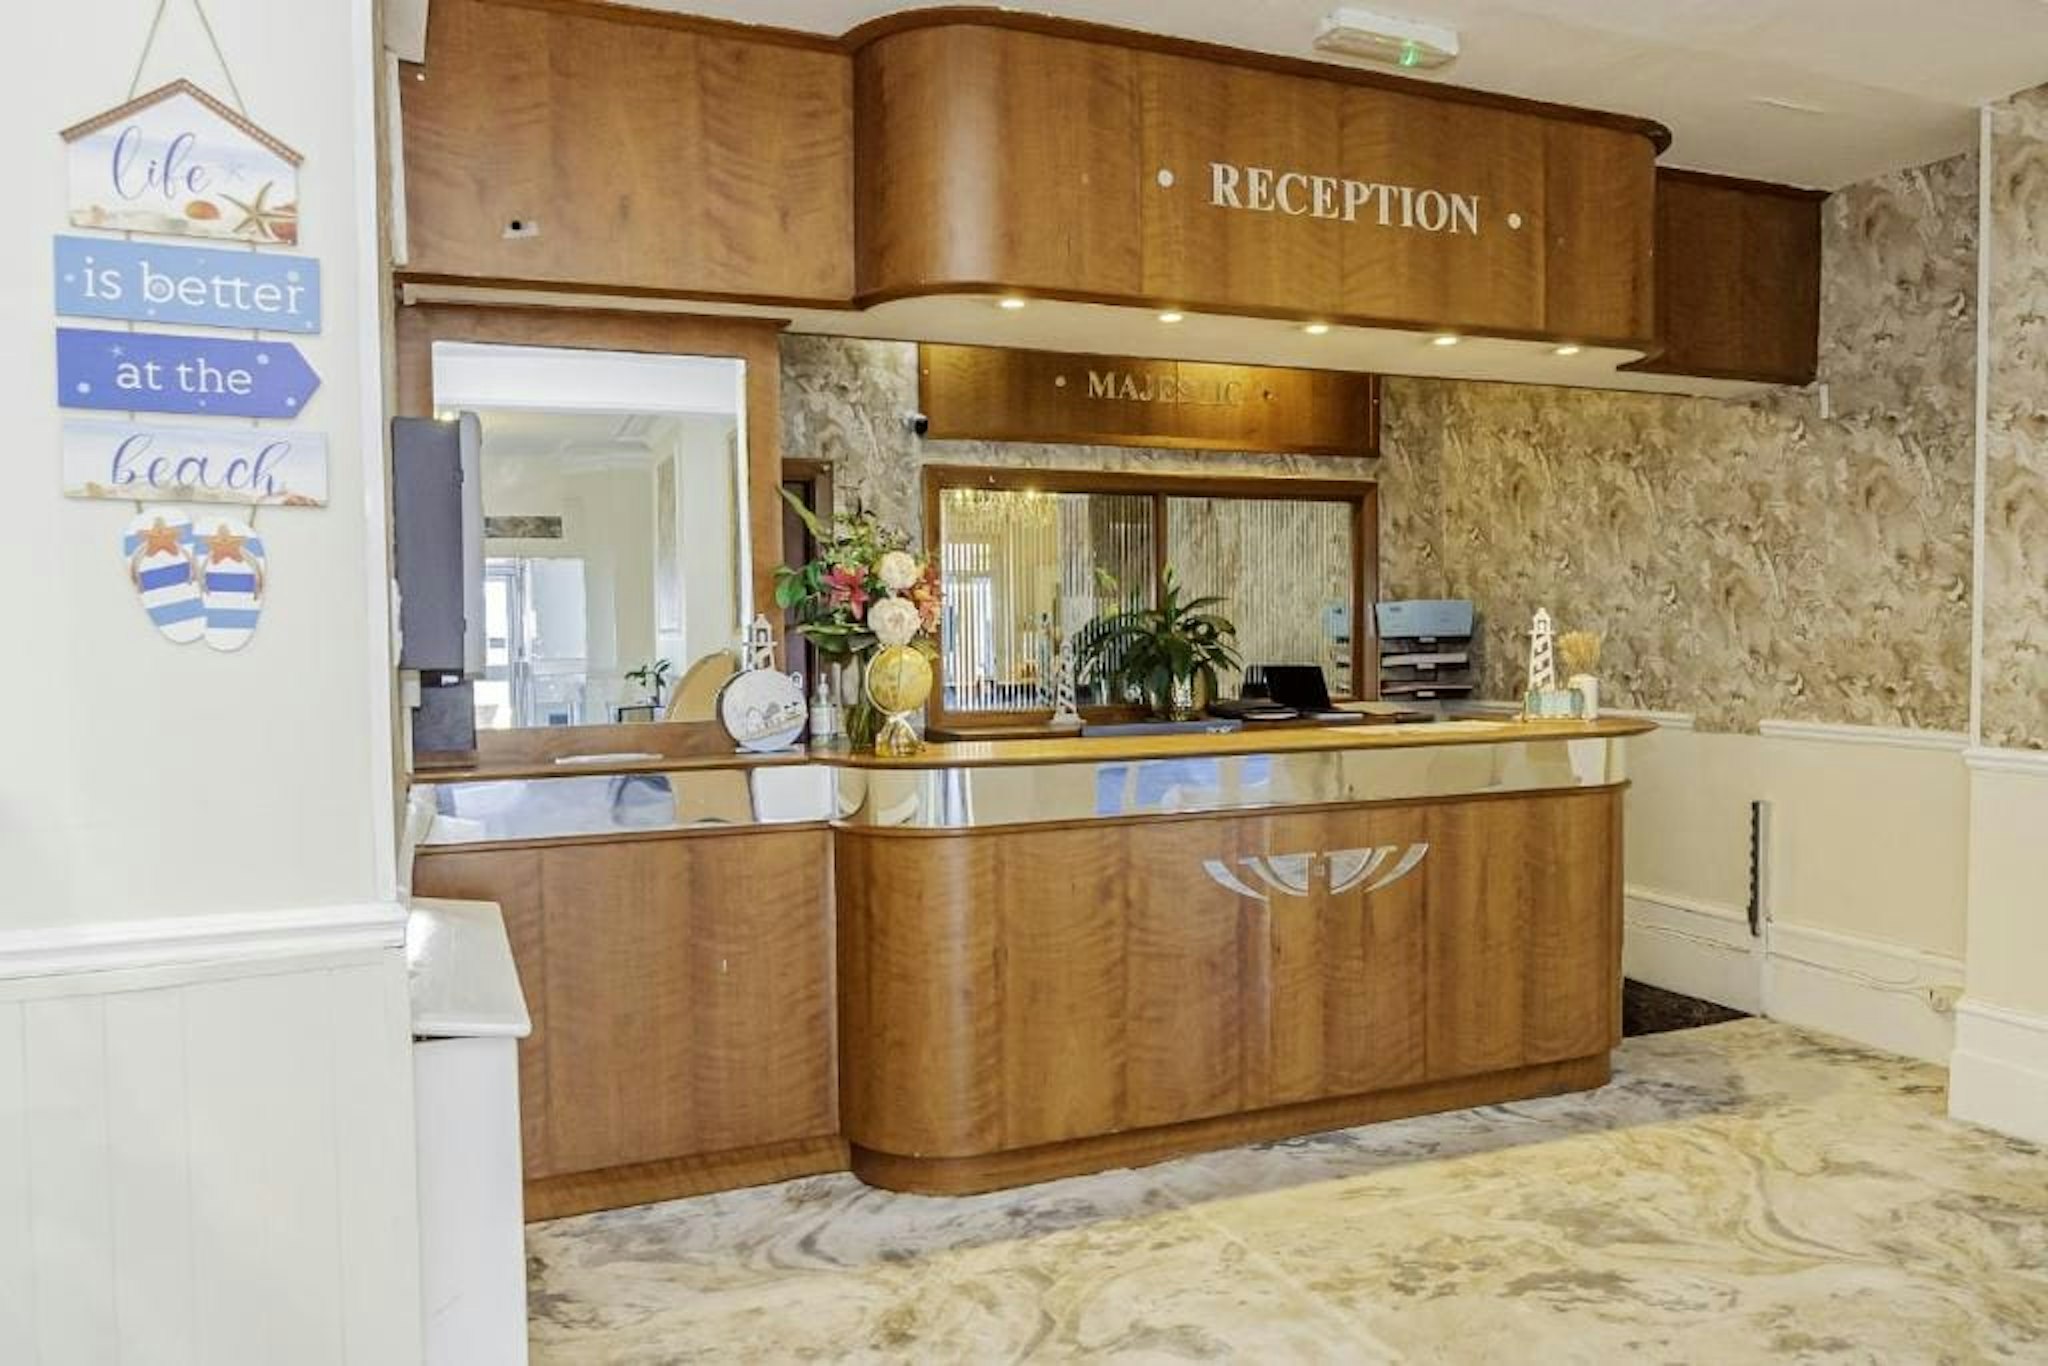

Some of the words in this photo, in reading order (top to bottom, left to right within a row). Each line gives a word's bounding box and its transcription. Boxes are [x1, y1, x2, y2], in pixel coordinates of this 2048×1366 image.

[113, 125, 211, 200] life
[1208, 161, 1480, 235] RECEPTION
[84, 256, 122, 300] is
[139, 260, 305, 314] better
[115, 360, 163, 390] at
[177, 358, 253, 395] the
[1088, 370, 1242, 406] MAJESIC
[111, 433, 292, 496] beach
